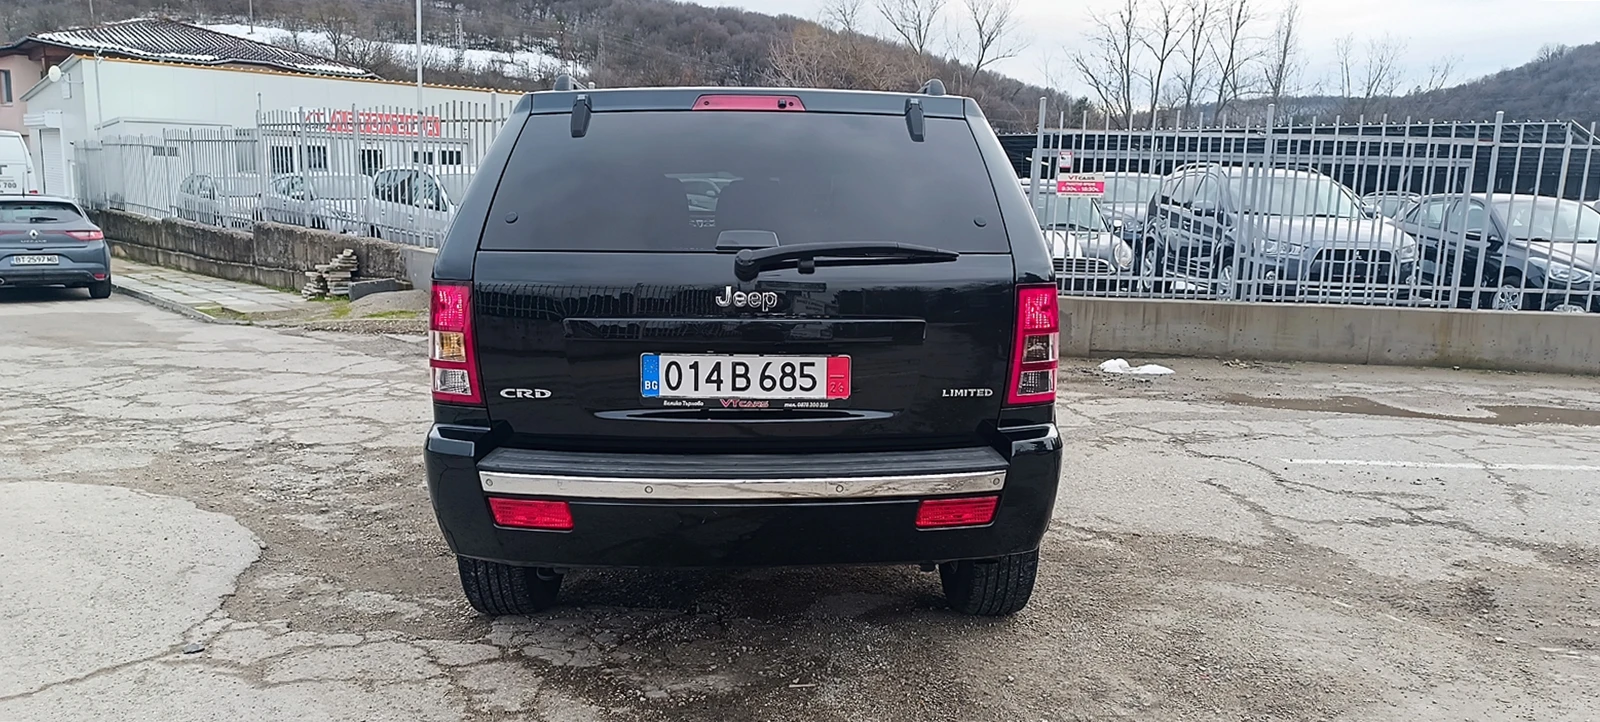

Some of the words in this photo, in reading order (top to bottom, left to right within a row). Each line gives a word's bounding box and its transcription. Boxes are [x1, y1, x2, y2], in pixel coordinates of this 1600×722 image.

[715, 286, 778, 311] Jeep
[644, 381, 658, 390] BG
[500, 388, 552, 398] CRD
[942, 388, 993, 397] LIMITED
